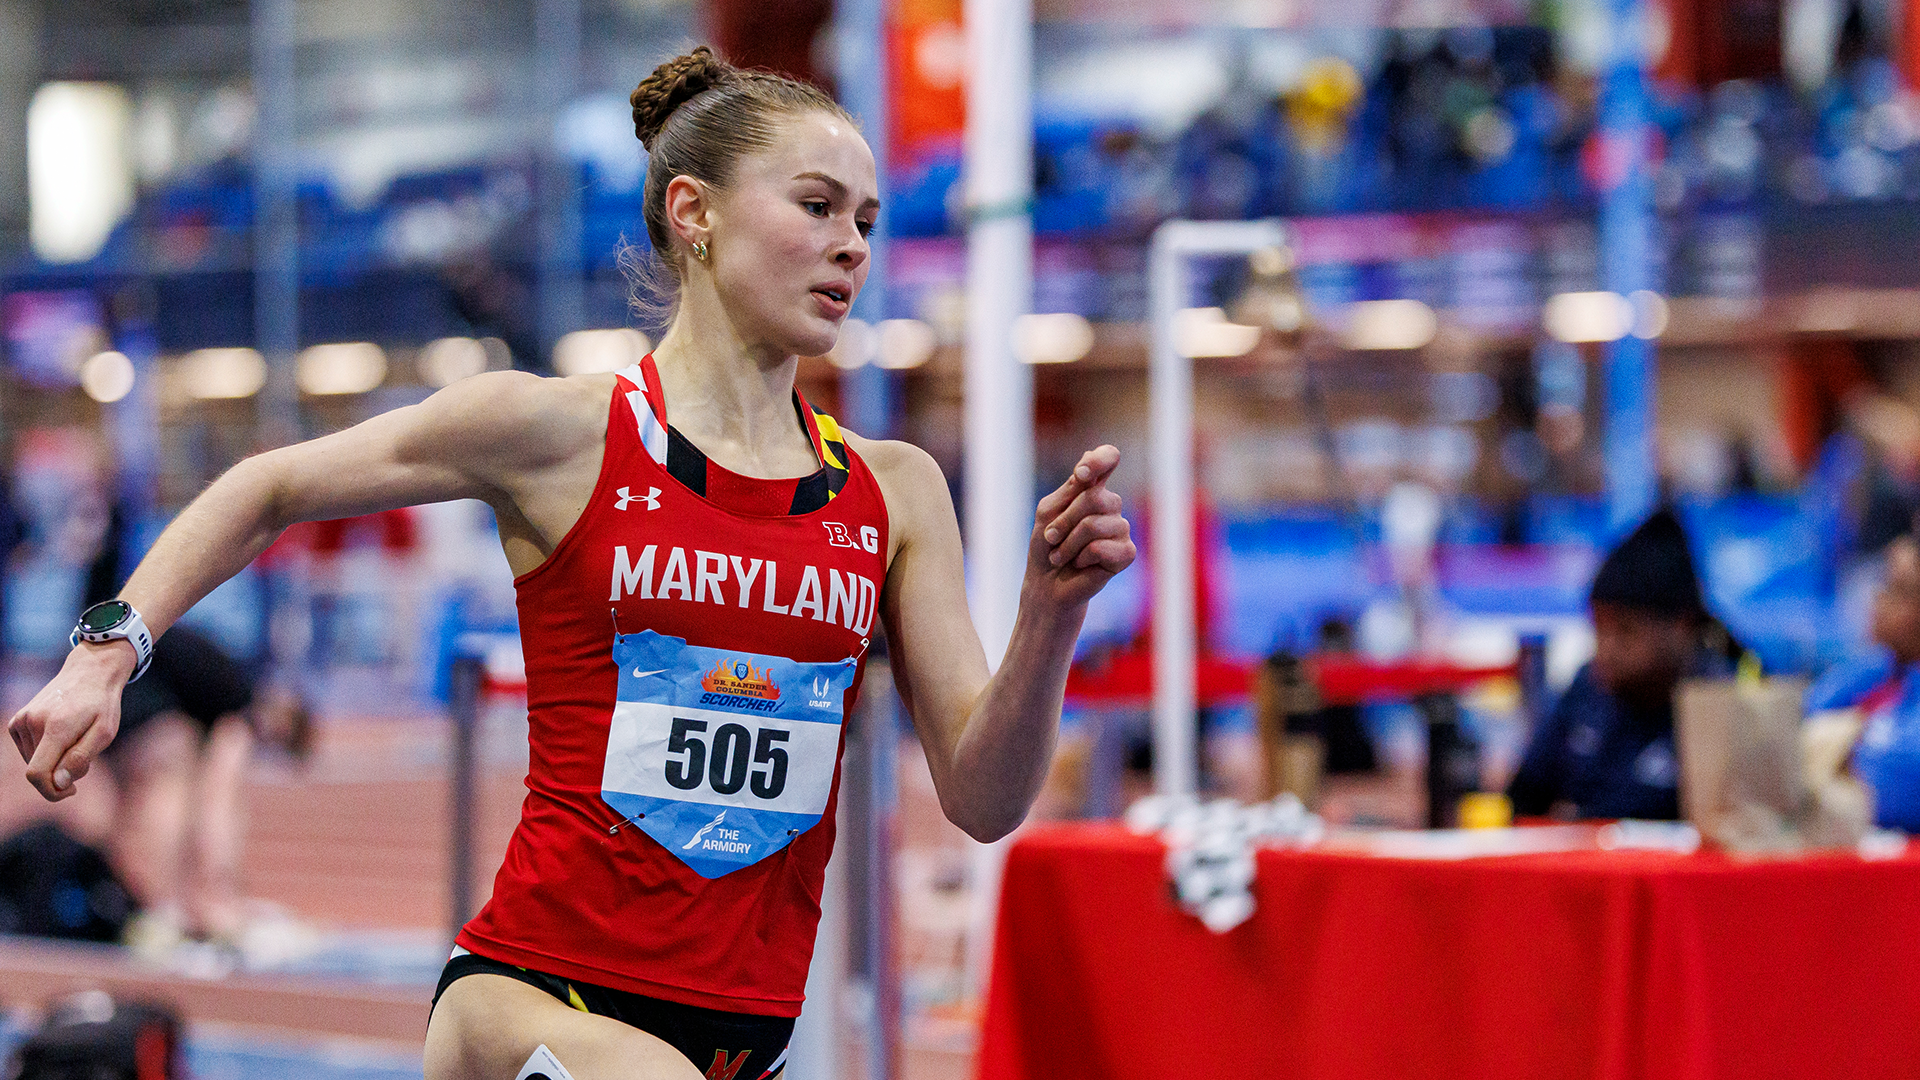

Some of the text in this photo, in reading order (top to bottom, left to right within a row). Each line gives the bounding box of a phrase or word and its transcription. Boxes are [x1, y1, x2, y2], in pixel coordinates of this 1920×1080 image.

[609, 544, 876, 637] MARYLAND
[716, 686, 763, 697] COLUMBIA
[731, 681, 767, 691] SANDER
[809, 700, 831, 708] USATF
[664, 717, 790, 799] 505
[718, 828, 740, 841] THE
[702, 839, 751, 854] ARMORY
